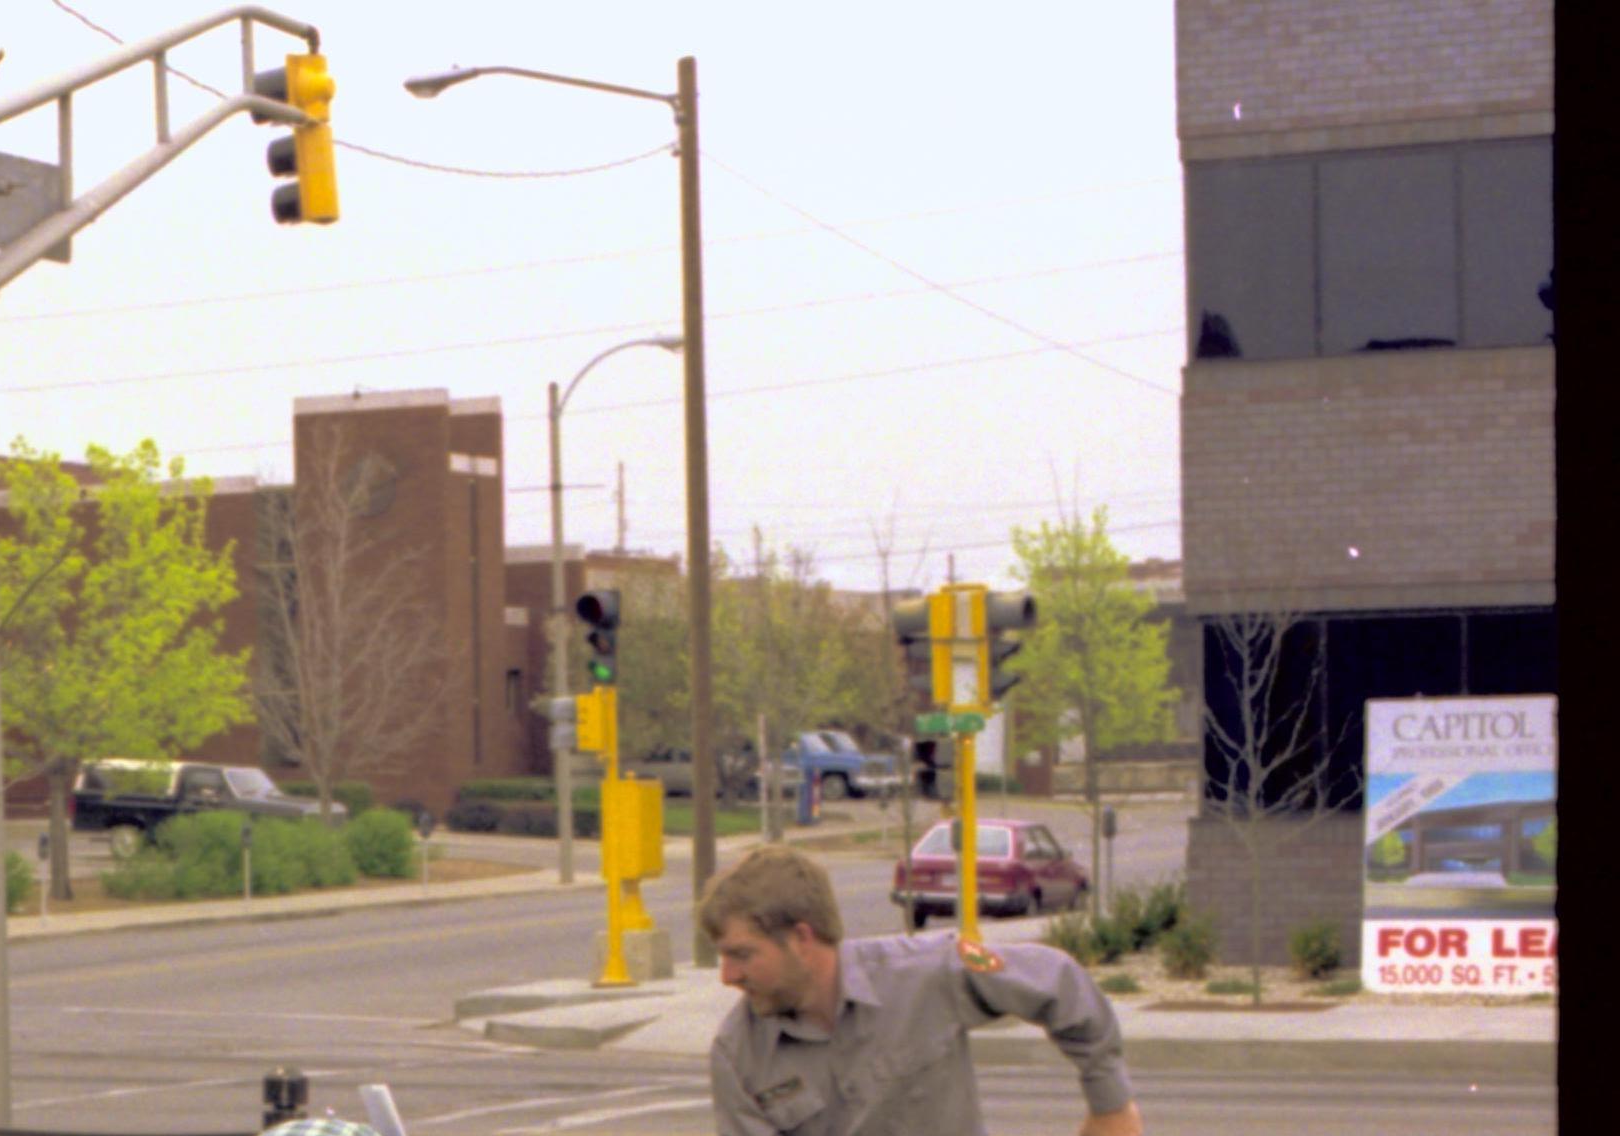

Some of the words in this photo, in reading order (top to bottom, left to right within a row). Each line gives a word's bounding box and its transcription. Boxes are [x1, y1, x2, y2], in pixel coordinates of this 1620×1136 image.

[1392, 711, 1535, 741] CAPITOL
[1378, 928, 1468, 957] FOR
[1493, 965, 1522, 984] FT.
